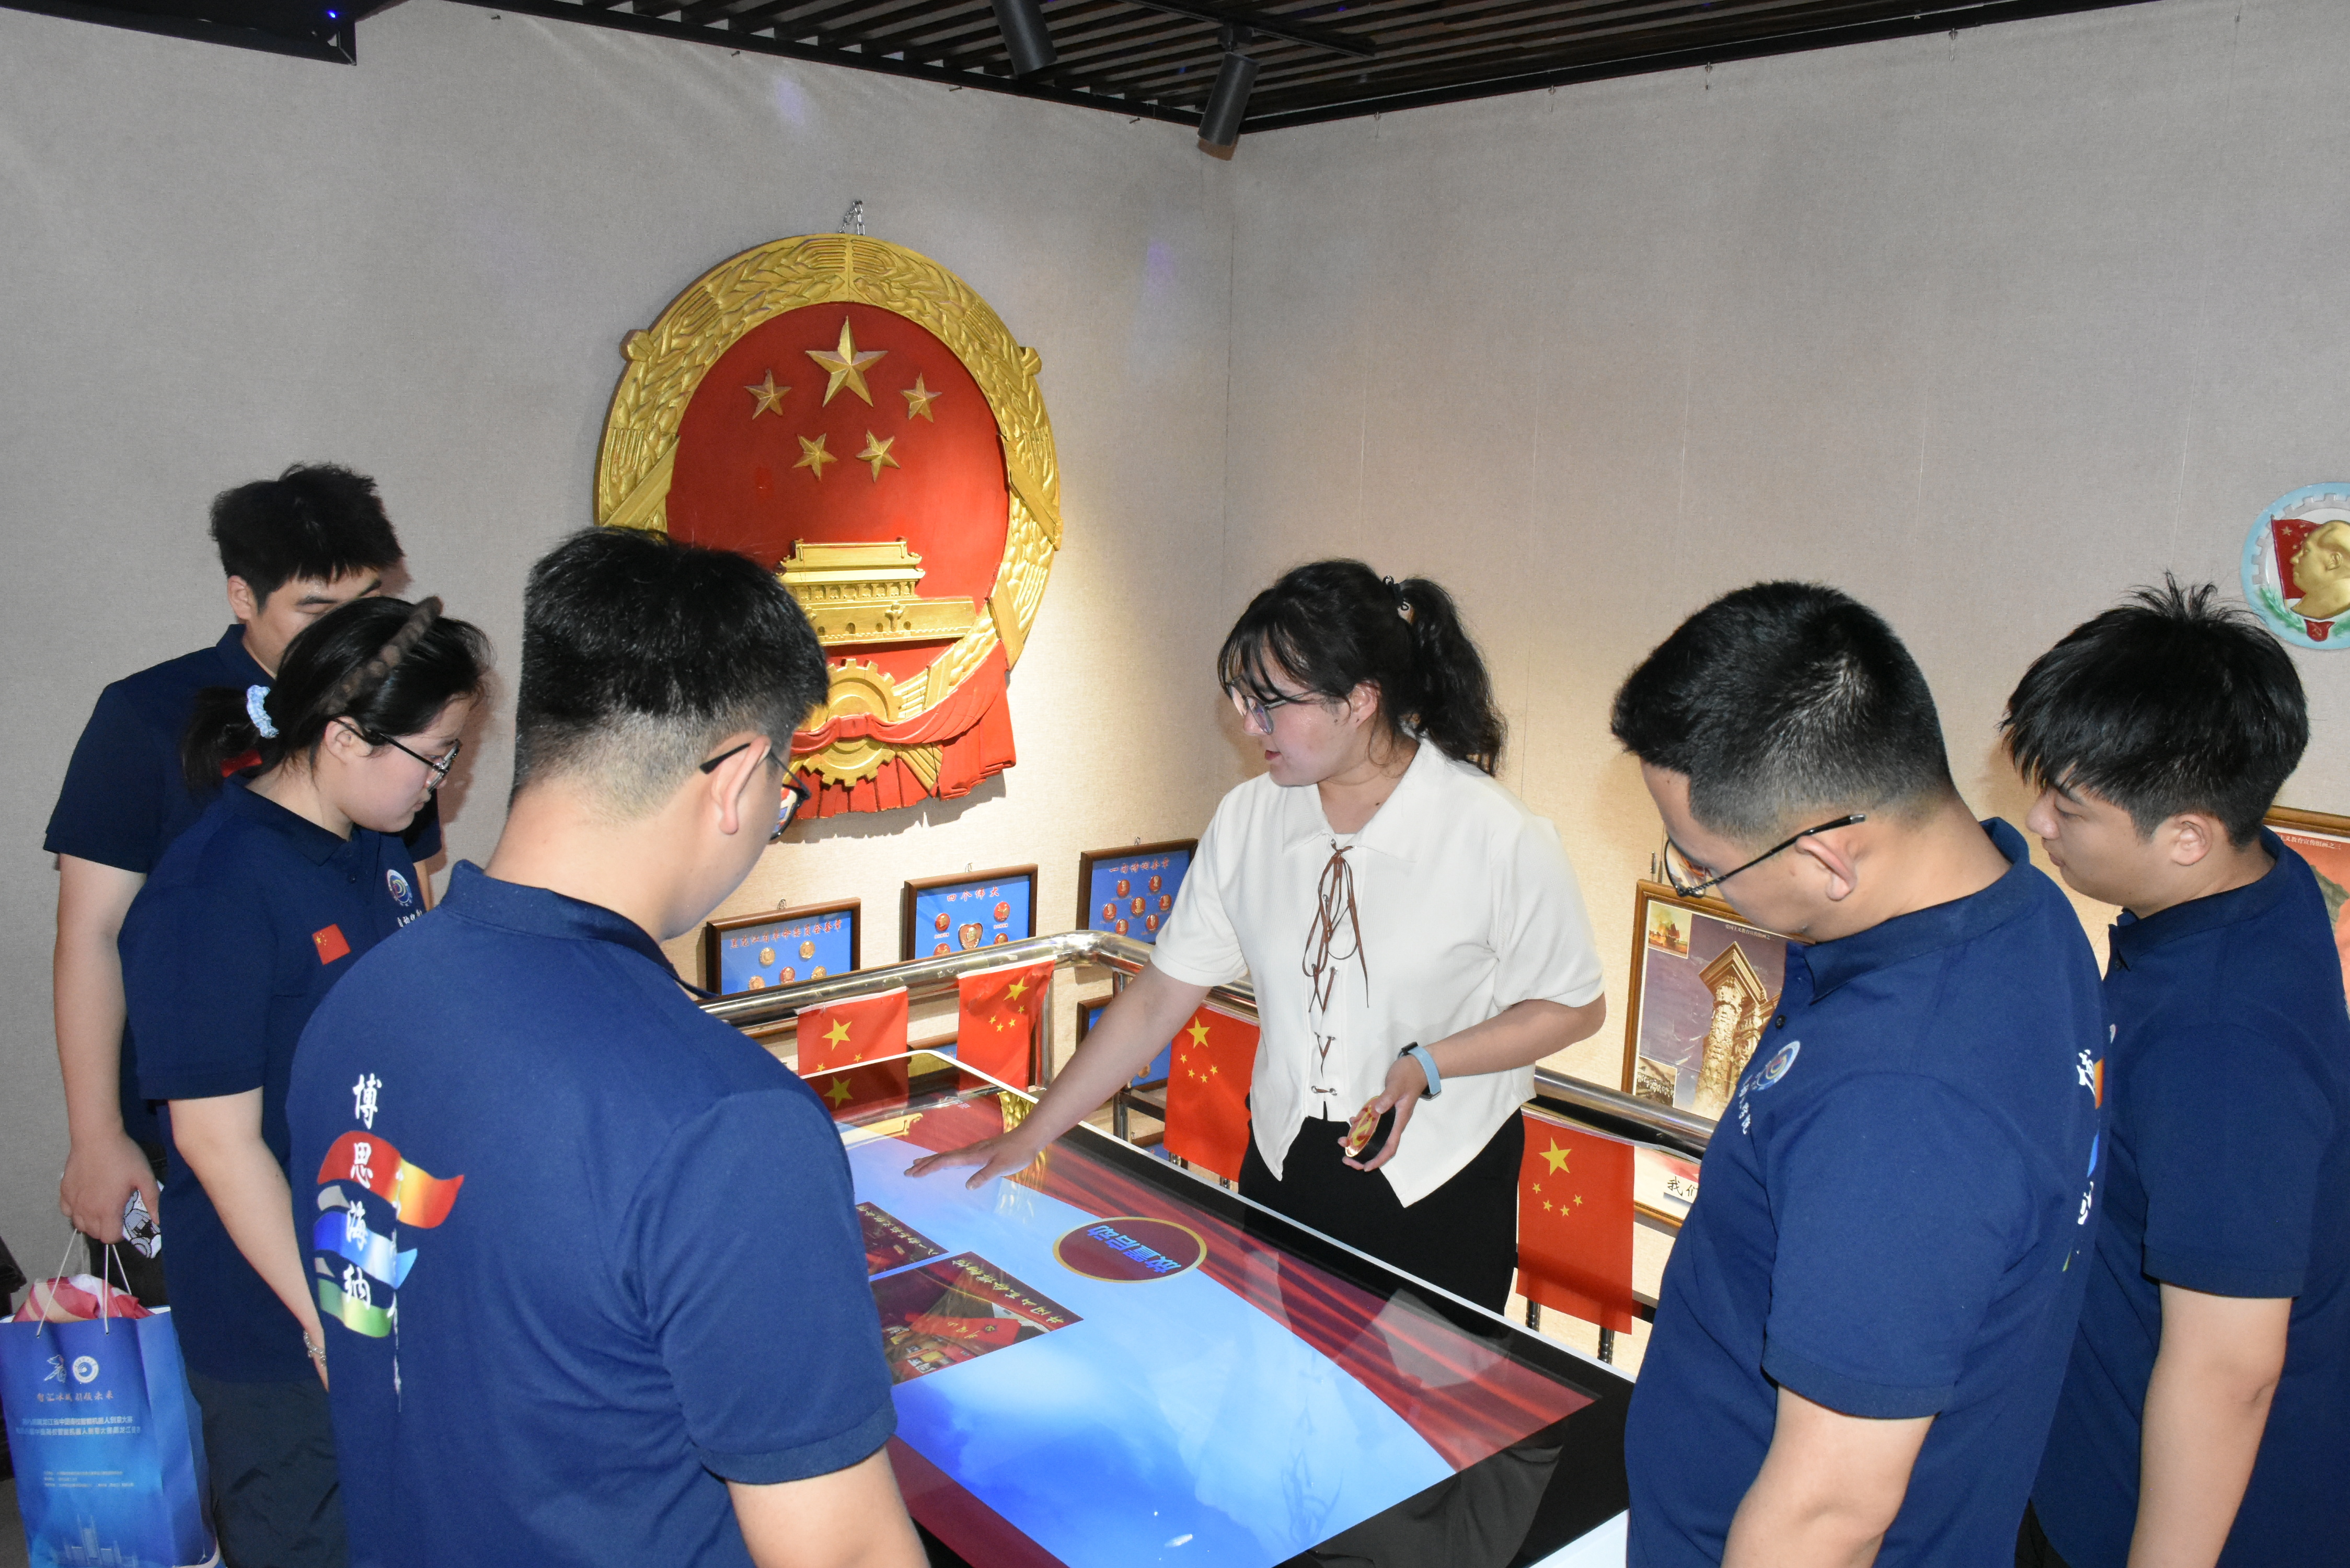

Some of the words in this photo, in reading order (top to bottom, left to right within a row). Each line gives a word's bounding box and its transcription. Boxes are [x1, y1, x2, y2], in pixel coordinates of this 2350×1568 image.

[1109, 857, 1170, 874] 一句诗词套章
[947, 886, 999, 902] 四个伟大
[730, 918, 842, 949] 黑龙江省革命委员会套章
[1087, 1225, 1181, 1273] 放置启动
